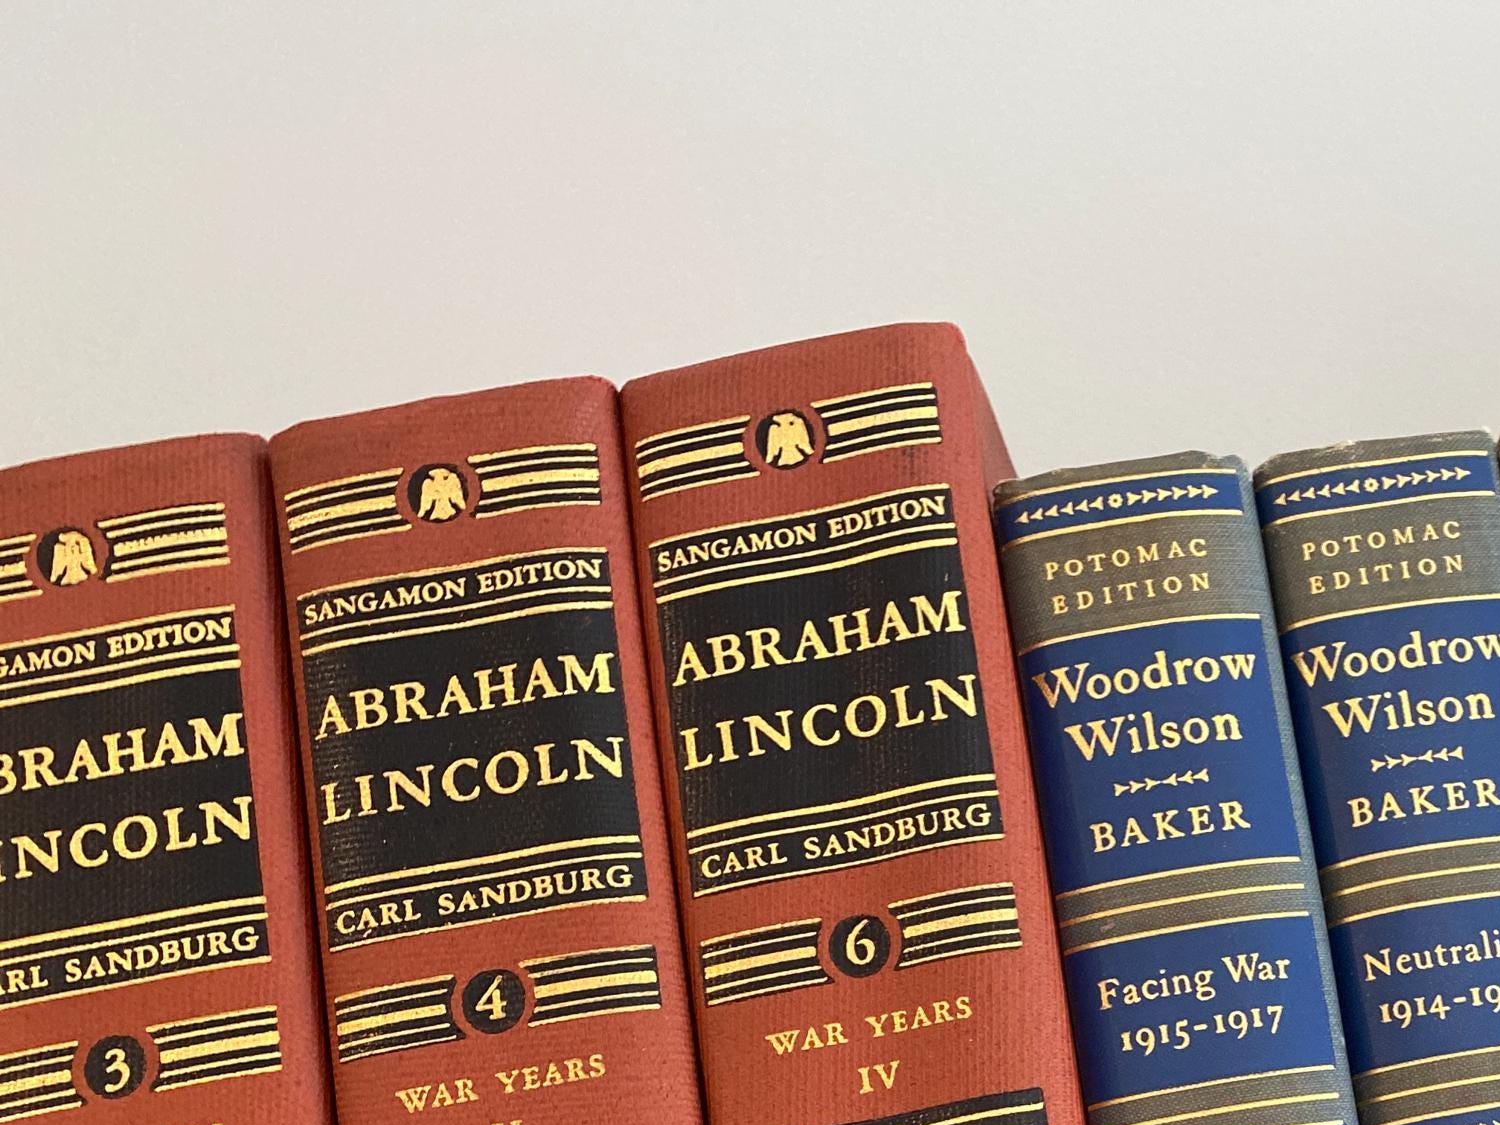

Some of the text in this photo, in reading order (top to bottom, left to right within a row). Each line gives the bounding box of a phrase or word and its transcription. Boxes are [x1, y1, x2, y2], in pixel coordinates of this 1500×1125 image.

[657, 495, 946, 573] SANGAMON EDITION
[1045, 538, 1208, 581] POTOMAC
[1302, 520, 1461, 561] POTOMAC
[304, 558, 603, 626] SANGAMON EDITION
[1052, 572, 1210, 615] EDITION
[1309, 554, 1463, 595] EDITION
[106, 616, 232, 659] EDITION
[672, 590, 967, 687] ABRAHAM
[314, 652, 616, 741] ABRAHAM
[1032, 650, 1256, 708] Woodrow
[679, 673, 978, 771] LINCOLN
[1063, 710, 1243, 761] Wilson
[1321, 689, 1496, 738] Wilson
[320, 736, 625, 826] LINCOLN
[701, 803, 992, 878] CARL SANDBURG
[1089, 800, 1251, 853] BAKER
[335, 864, 634, 938] CARL SANDBURG
[0, 926, 260, 996] RL SANDBURG
[845, 919, 876, 966] 6
[475, 974, 507, 1020] 4
[1097, 952, 1291, 1010] Facing War
[764, 996, 973, 1055] WAR YEARS
[1120, 1005, 1284, 1056] 1915-1917
[104, 1048, 131, 1093] 3
[394, 1053, 606, 1114] WAR YEARS
[857, 1059, 900, 1095] IV
